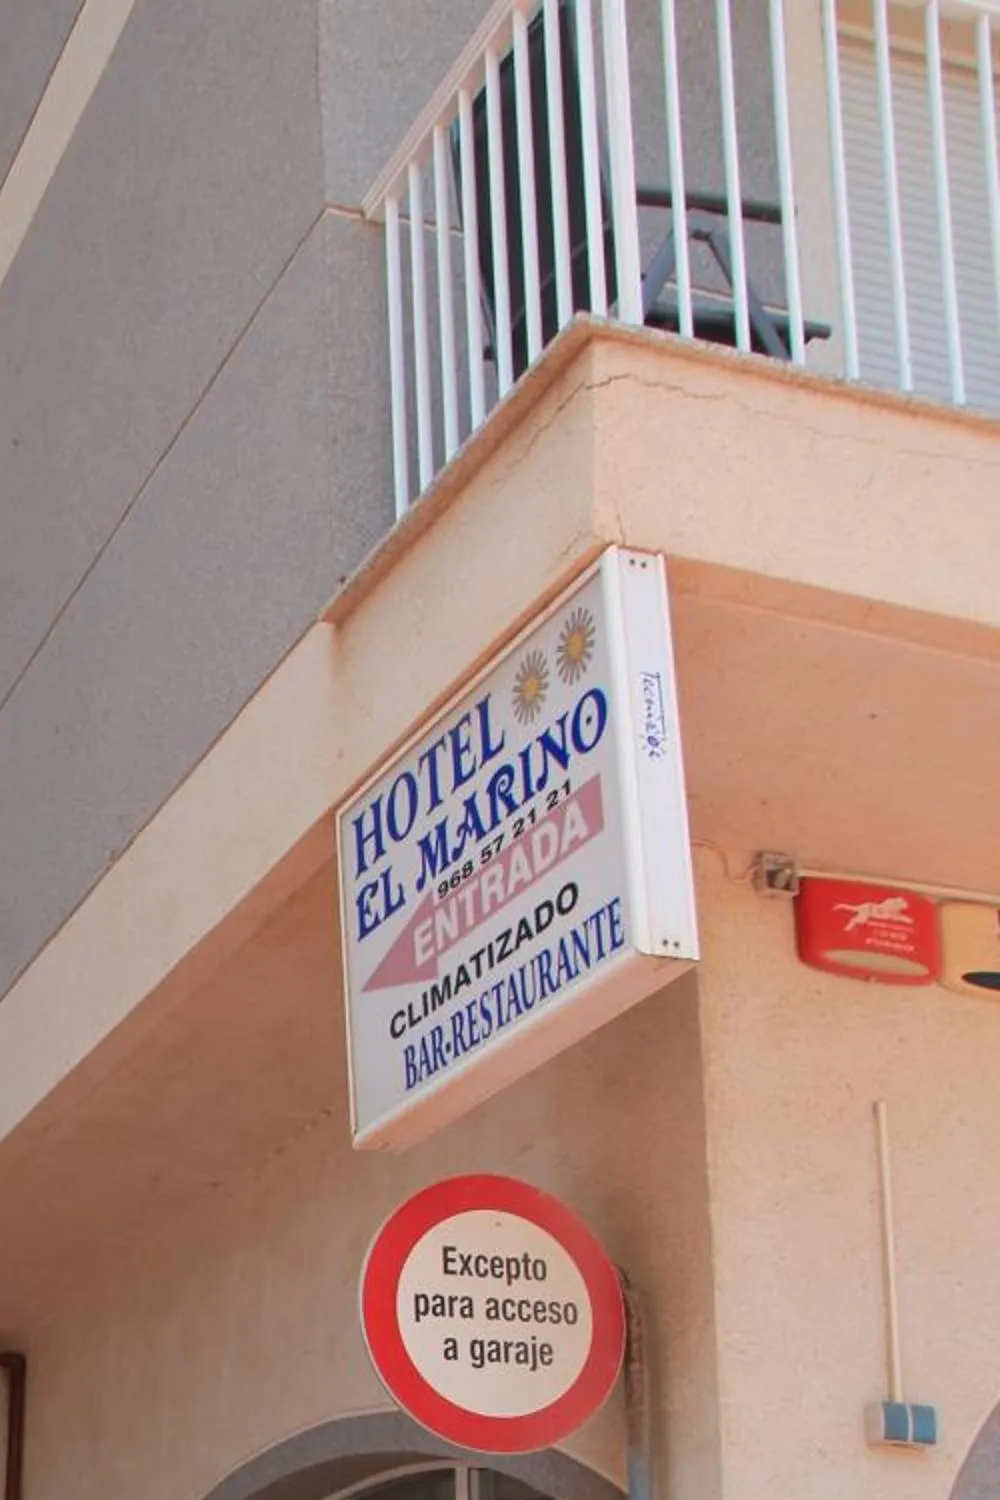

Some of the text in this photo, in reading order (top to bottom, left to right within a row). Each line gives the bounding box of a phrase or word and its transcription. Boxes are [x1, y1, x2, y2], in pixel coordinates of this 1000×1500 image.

[352, 692, 506, 880] HOTEL
[355, 865, 406, 942] EL
[416, 687, 608, 893] MARINO
[437, 779, 571, 899] 968 57 21 21
[413, 798, 589, 968] ENTRADA
[389, 881, 579, 1039] CLIMATIZADO
[413, 1292, 579, 1325] para acceso
[442, 1245, 548, 1286] Excepto
[443, 1336, 554, 1372] a garaje
